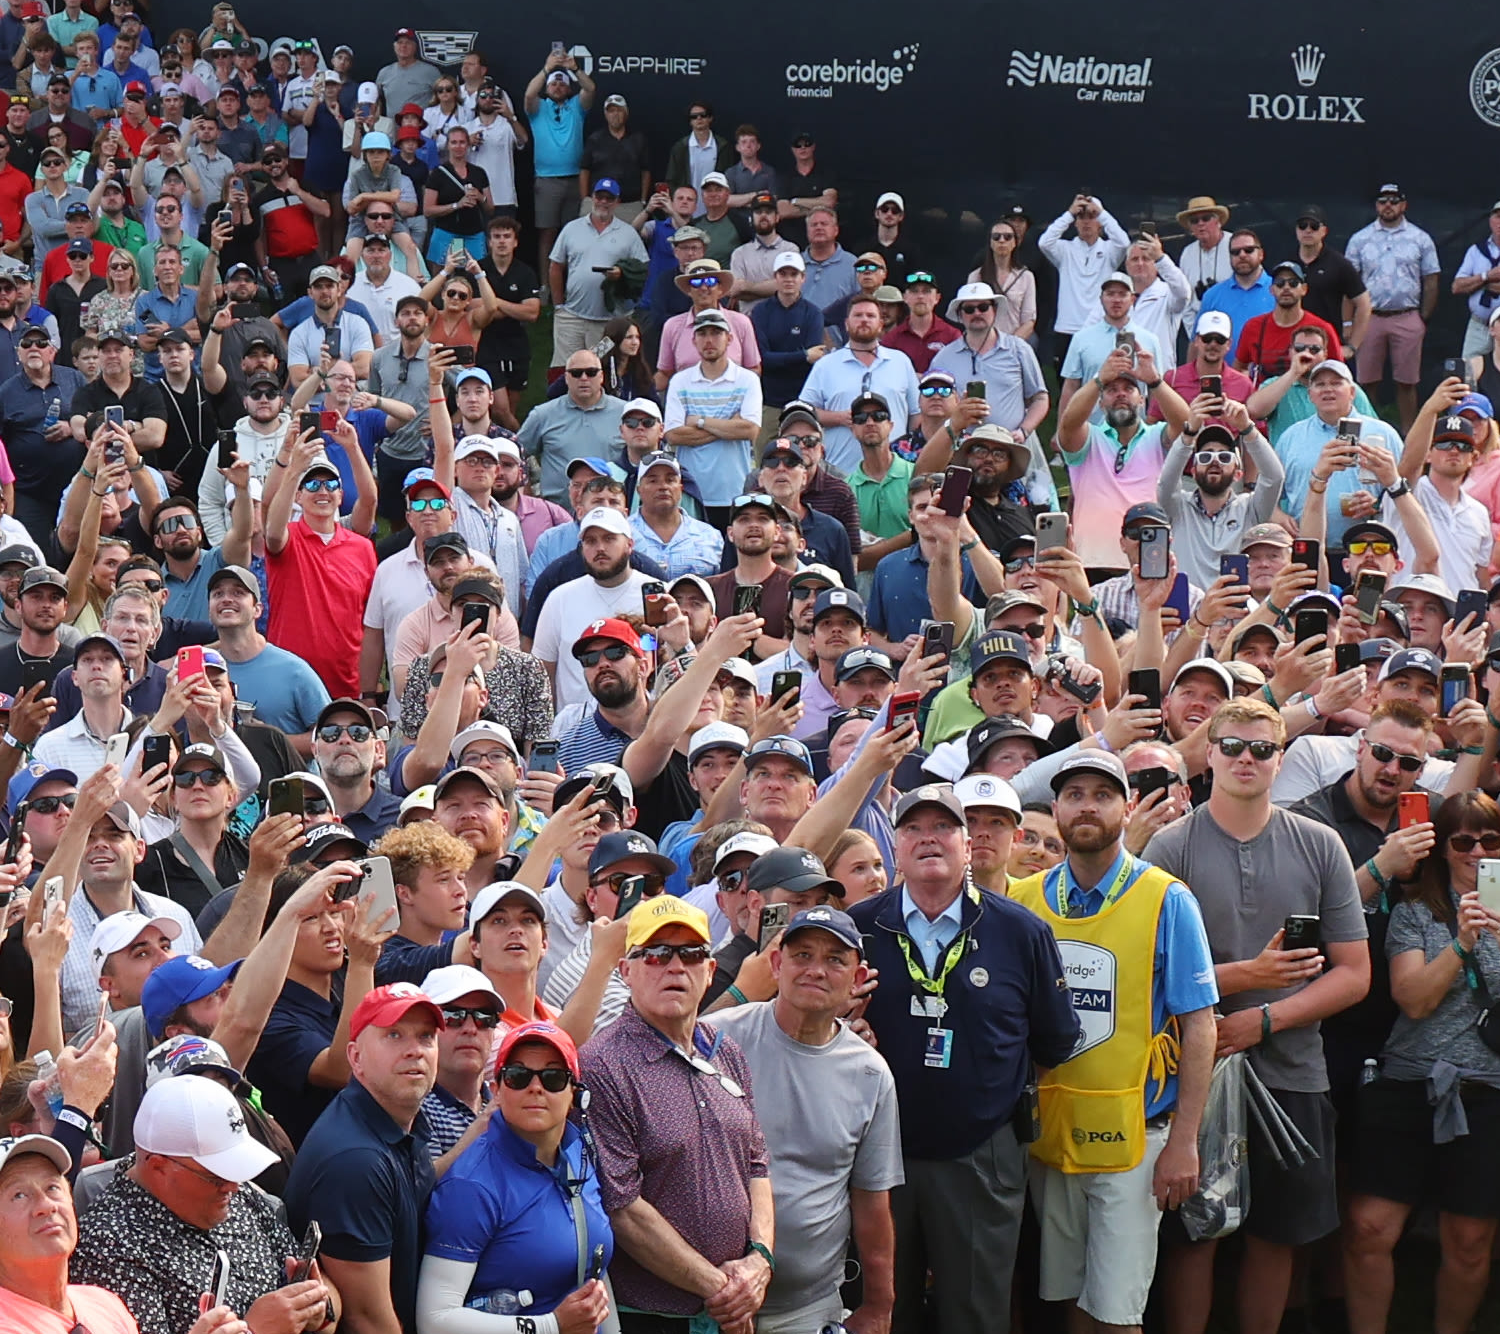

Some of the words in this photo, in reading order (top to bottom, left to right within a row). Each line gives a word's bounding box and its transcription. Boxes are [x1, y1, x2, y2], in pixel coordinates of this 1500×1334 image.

[598, 55, 702, 75] SAPPHIRE
[1038, 54, 1151, 88] National
[786, 59, 904, 91] corebridge
[787, 85, 833, 98] financial
[1076, 88, 1099, 102] Car
[1102, 89, 1145, 103] Rental
[1248, 94, 1366, 123] ROLEX
[979, 637, 1017, 656] HILL
[1072, 992, 1107, 1009] EAM
[1088, 1130, 1127, 1144] PGA
